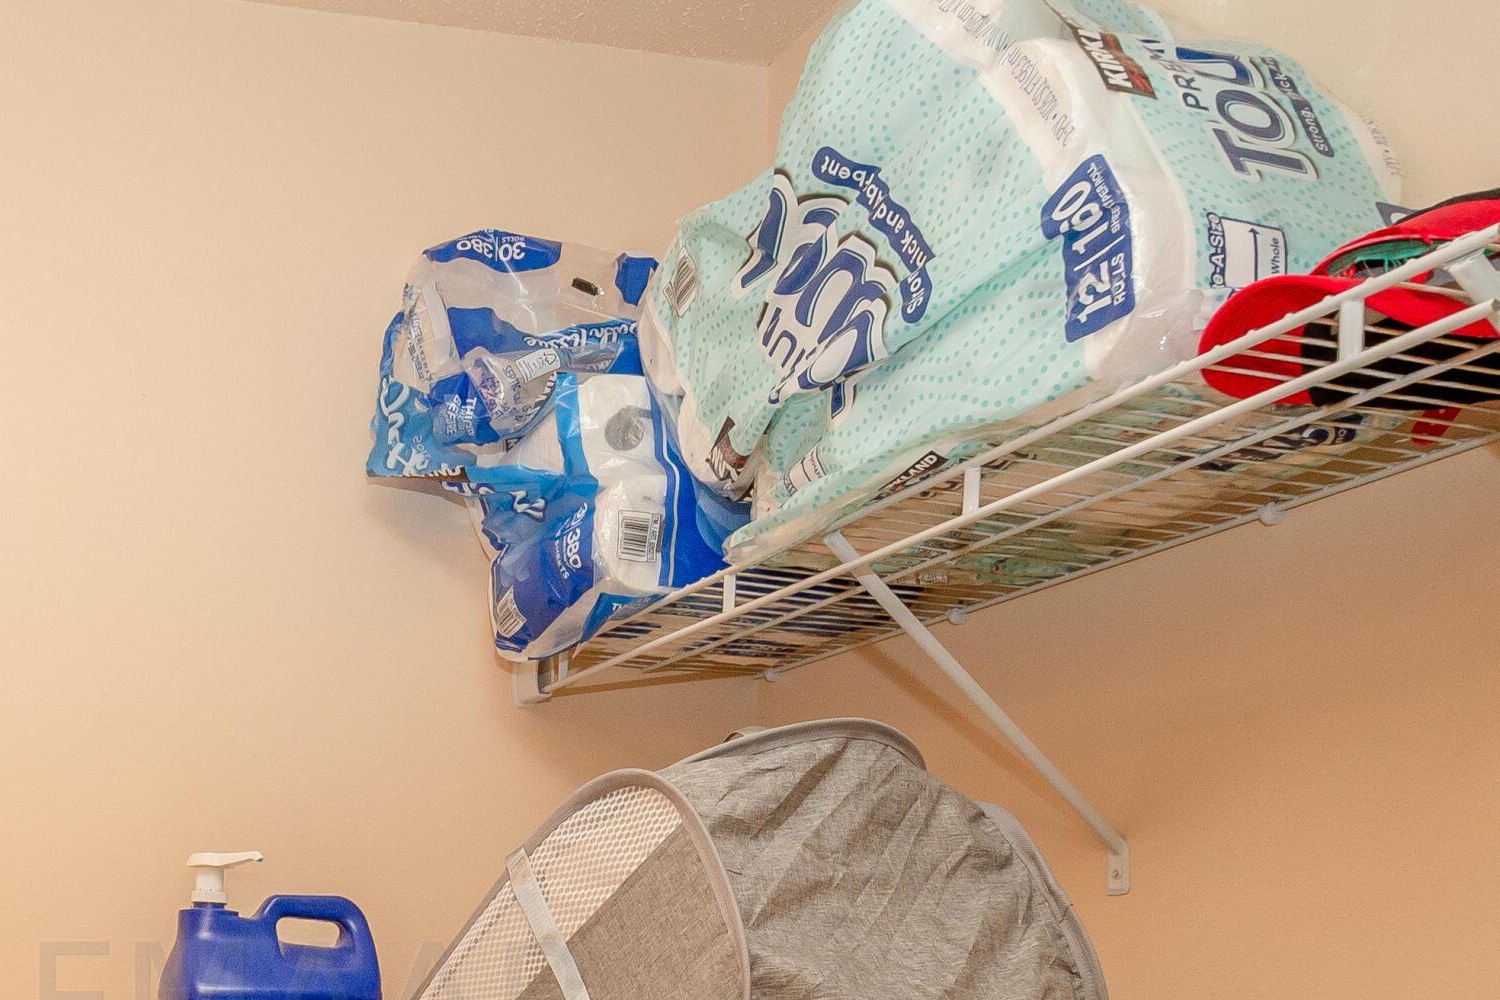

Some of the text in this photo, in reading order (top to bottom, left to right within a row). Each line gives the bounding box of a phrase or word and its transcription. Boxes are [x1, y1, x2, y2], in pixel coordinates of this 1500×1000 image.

[456, 239, 526, 262] 30 380
[1270, 237, 1281, 275] Whole
[1077, 261, 1112, 324] 12
[566, 527, 582, 569] 380
